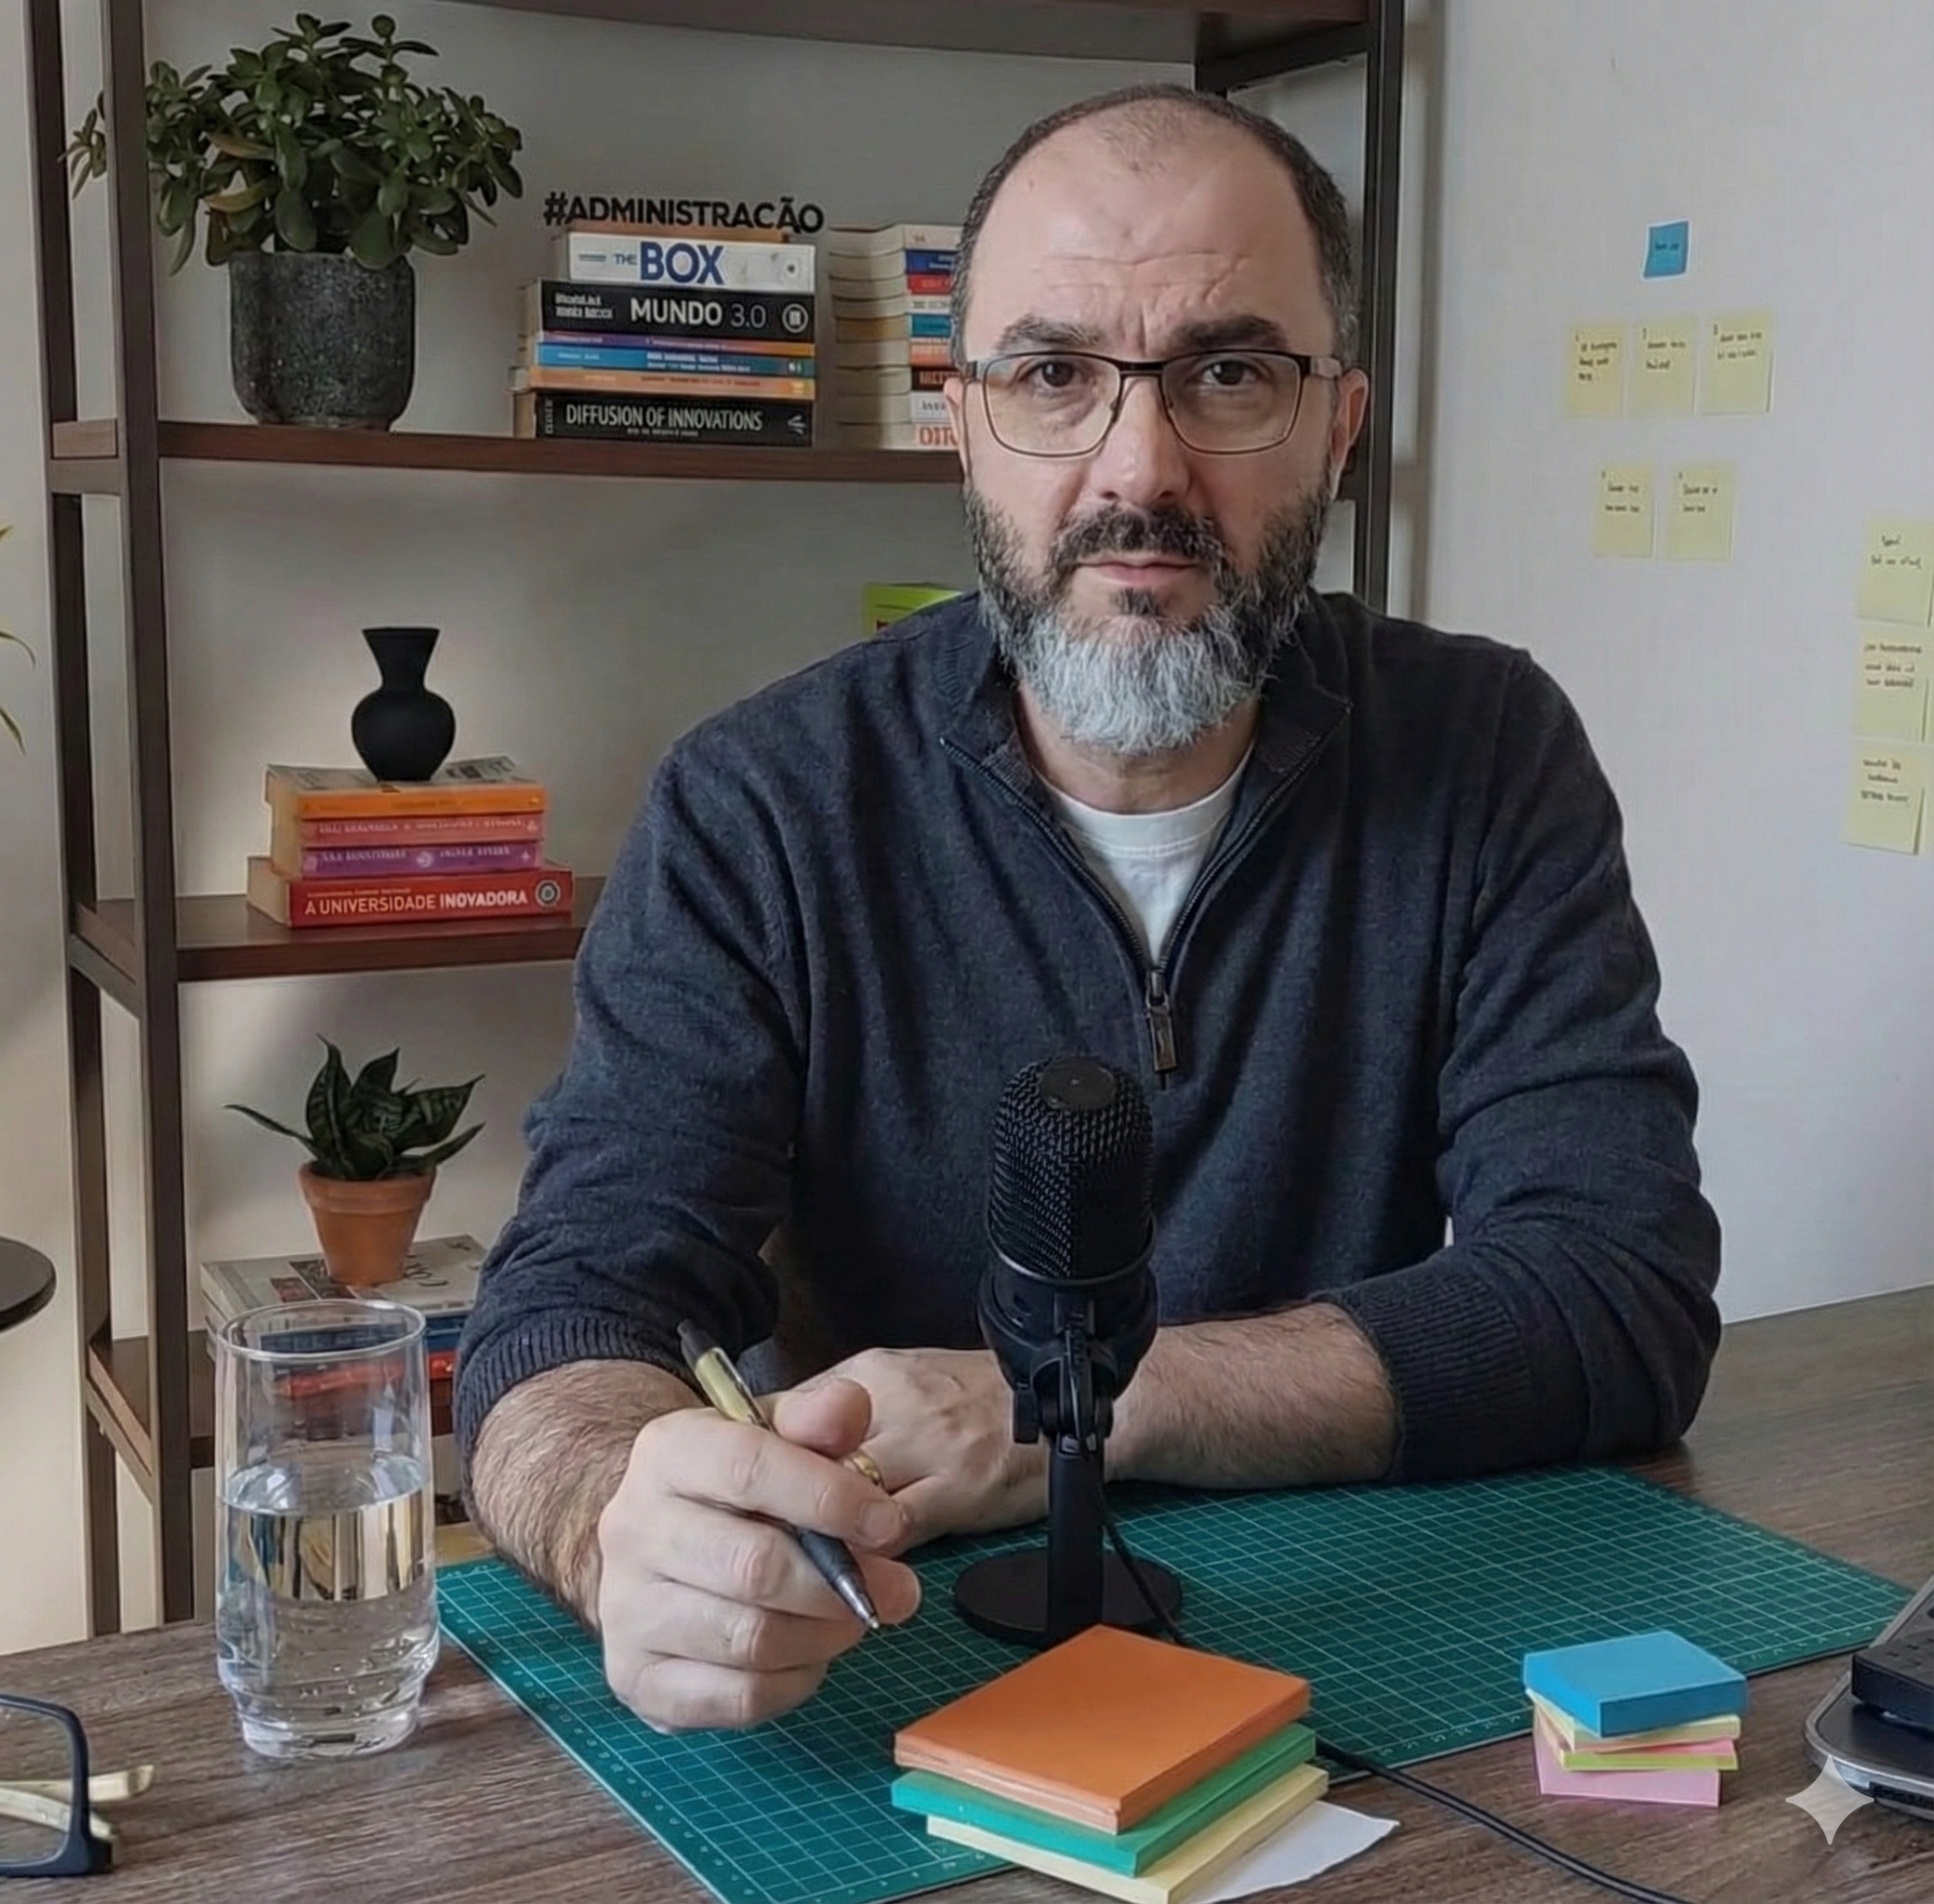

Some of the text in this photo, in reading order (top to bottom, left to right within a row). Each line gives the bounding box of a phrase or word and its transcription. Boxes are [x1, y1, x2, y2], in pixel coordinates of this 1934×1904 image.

[614, 240, 724, 284] THE BOX
[630, 298, 722, 325] MUNDO
[731, 303, 766, 328] 3.0
[566, 403, 643, 428] DIFFUSION
[645, 406, 665, 428] OF
[668, 408, 762, 431] INNOVATIONS
[305, 890, 527, 916] A UNIVERSIDADE INOVADORA
